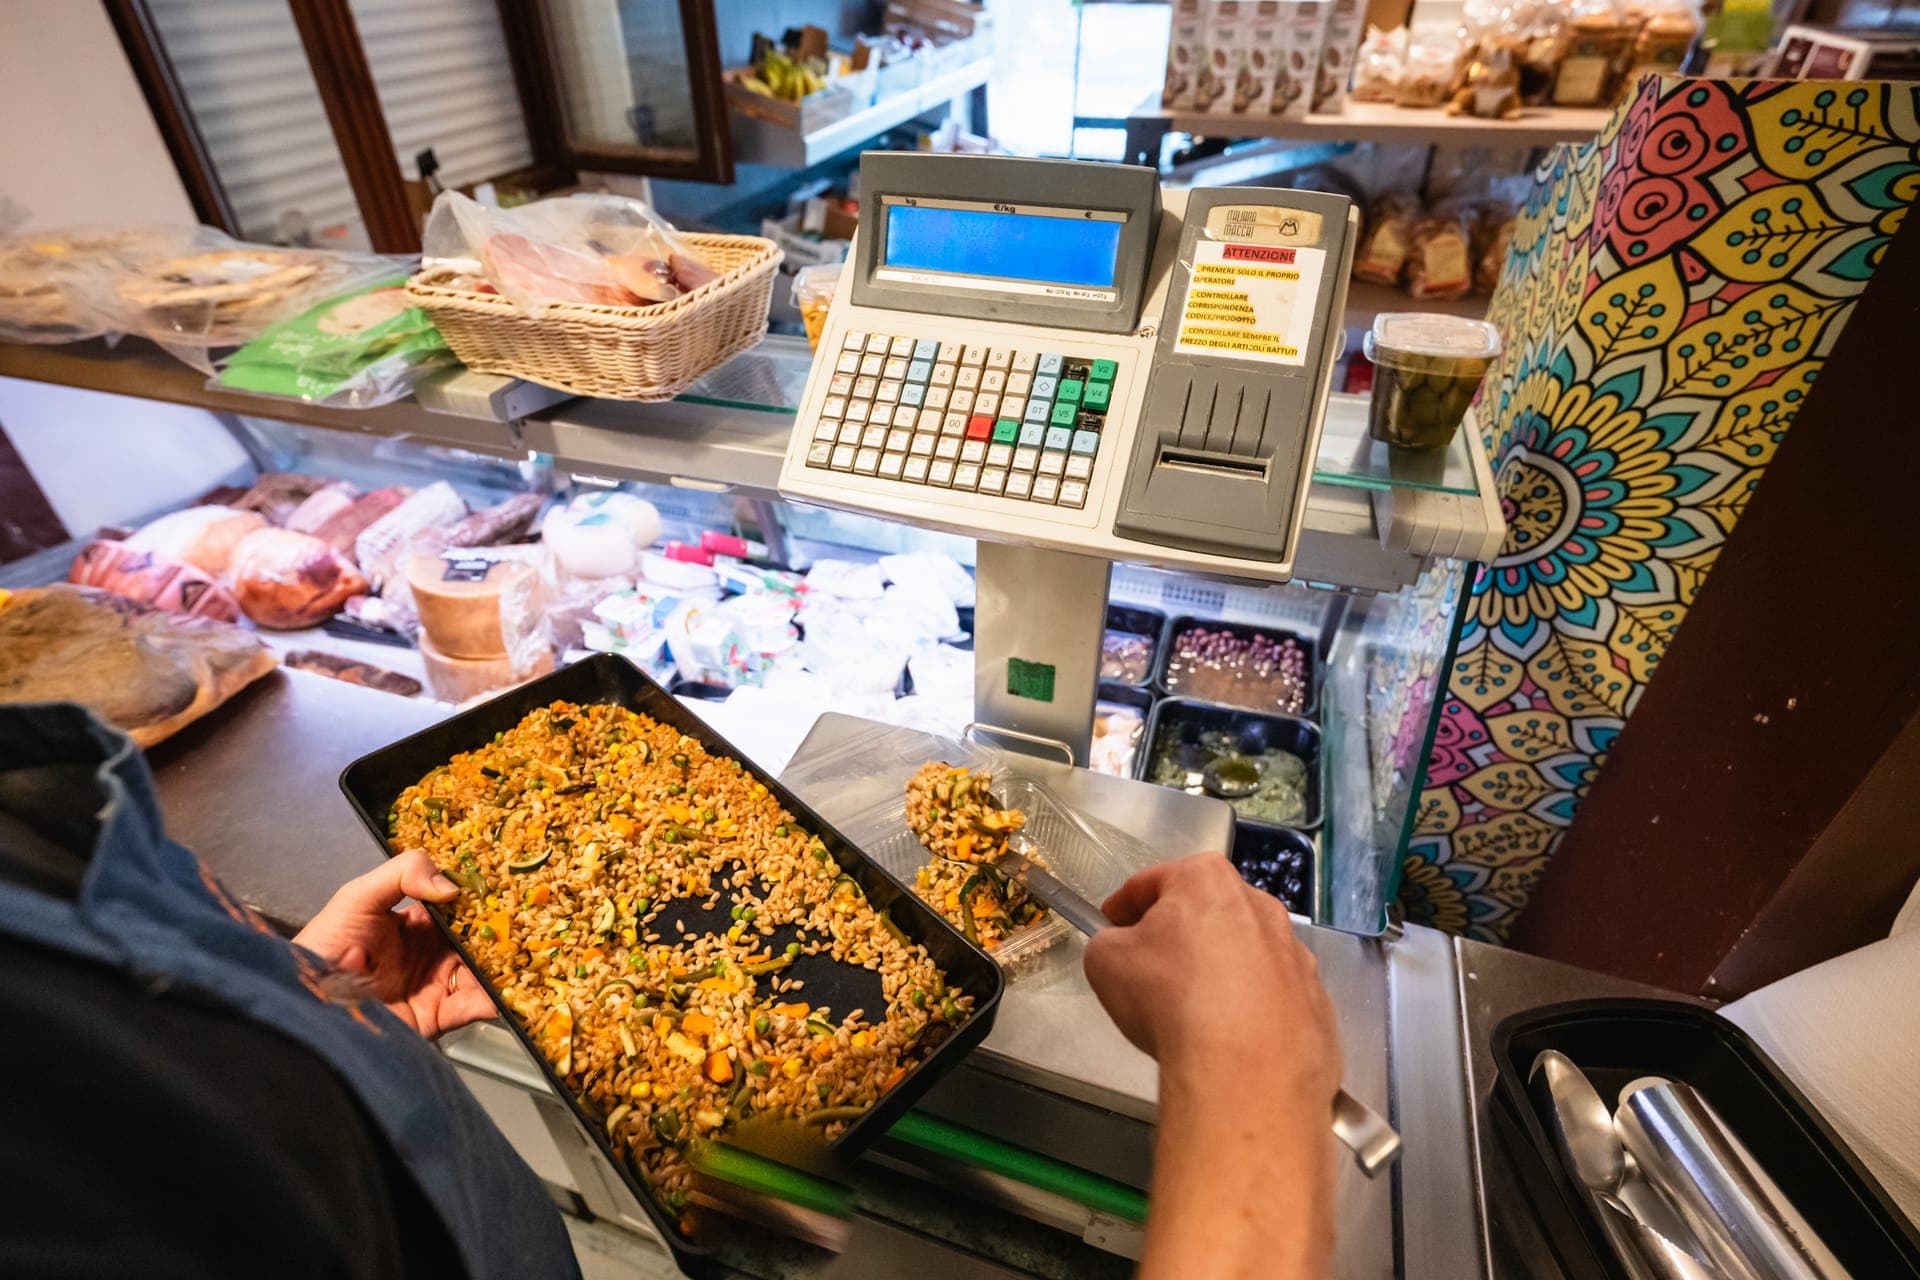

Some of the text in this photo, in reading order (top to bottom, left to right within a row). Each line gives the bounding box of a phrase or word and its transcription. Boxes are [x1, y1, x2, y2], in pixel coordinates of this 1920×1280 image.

[905, 197, 1092, 219] kg €/kg €
[1226, 209, 1257, 223] ITALIANA
[1223, 224, 1255, 238] MACCHI
[1223, 247, 1297, 262] ATTENZIONE
[1201, 265, 1300, 280] PREMERE SOLO IL PROPRIO
[1196, 291, 1249, 301] CONTROLLARE
[1187, 301, 1254, 313] CORRISPONDENZA
[1185, 312, 1256, 325] CODICE/PRODOTTO
[1188, 327, 1240, 338] CONTROLLARE
[1242, 331, 1272, 342] SEMPRE
[946, 347, 953, 355] 7
[1180, 337, 1208, 346] PREZZO
[1209, 340, 1230, 348] DEGLI
[1266, 346, 1298, 356] BATTUTI
[971, 350, 978, 358] 8
[996, 353, 1002, 361] 9
[940, 369, 946, 377] 4
[1097, 364, 1109, 374] V2
[964, 373, 971, 381] 5
[989, 376, 996, 384] 6
[1091, 388, 1103, 397] V4
[983, 399, 990, 407] 3
[1031, 406, 1044, 414] ST
[1058, 409, 1070, 418] V5
[948, 419, 960, 428] 00
